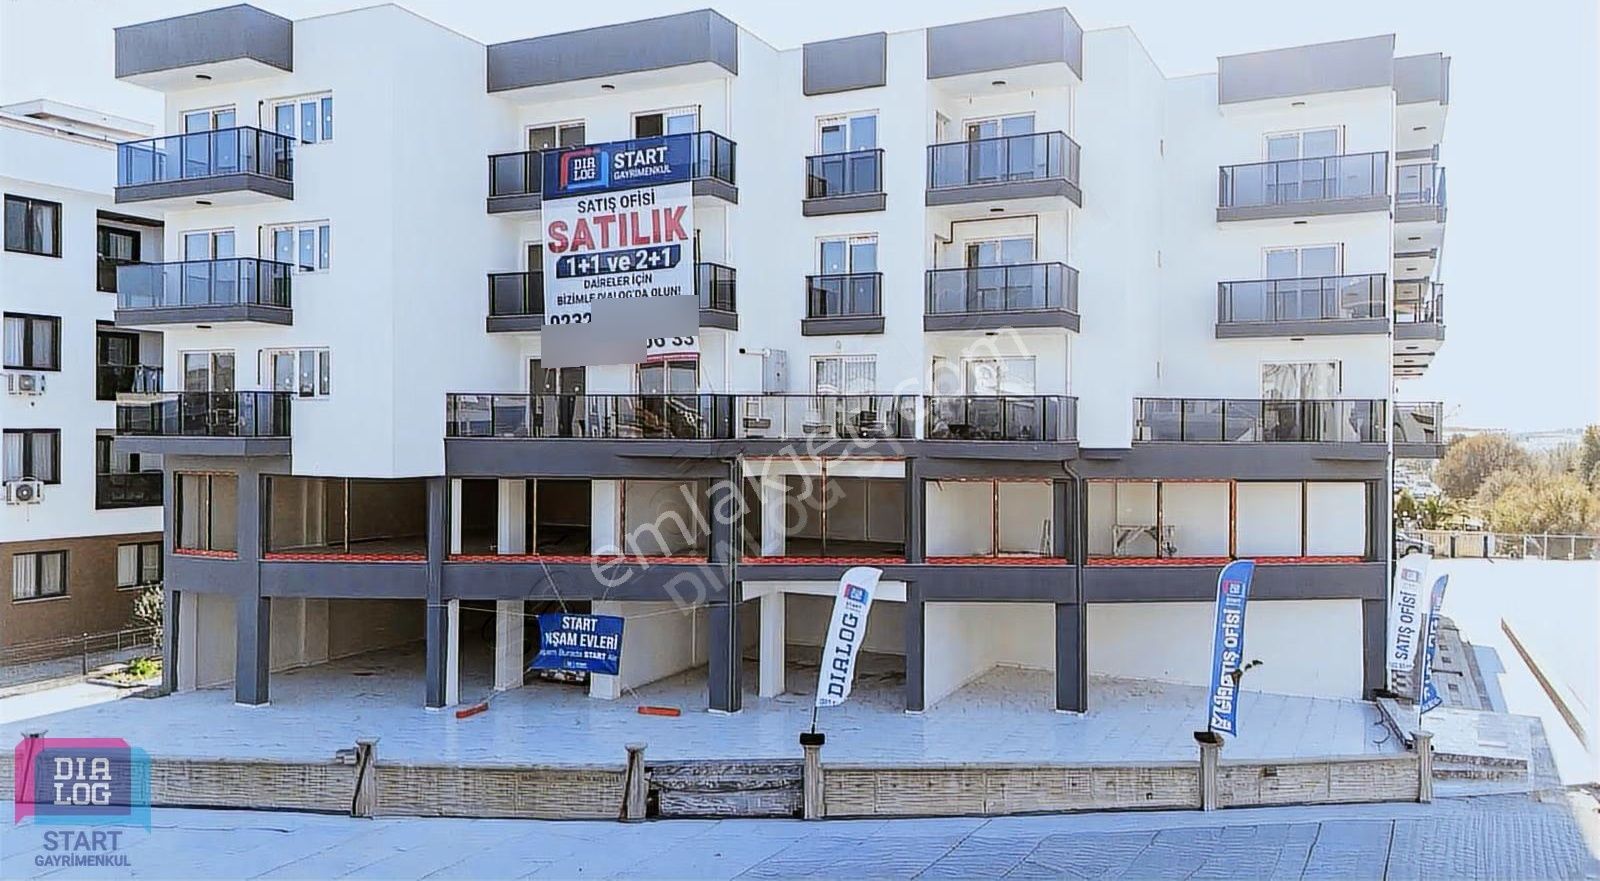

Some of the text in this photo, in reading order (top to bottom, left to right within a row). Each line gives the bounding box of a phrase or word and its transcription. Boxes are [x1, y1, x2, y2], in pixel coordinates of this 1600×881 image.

[574, 157, 596, 170] DIA
[614, 147, 668, 169] START
[574, 168, 596, 181] LOG
[577, 188, 655, 214] SATIŞ OFİSİ
[547, 205, 689, 253] SATILIK
[566, 248, 671, 276] 1+1 ve 2+1
[584, 272, 652, 289] DAİRELER İÇİN
[651, 286, 681, 297] OLUN!
[1397, 591, 1418, 624] OFİSİ
[561, 616, 599, 631] START
[1223, 608, 1241, 648] OFİSİ
[579, 634, 619, 650] EVLERİ
[1395, 625, 1412, 660] SATIŞ
[583, 651, 607, 660] START
[828, 612, 859, 698] DIALOG
